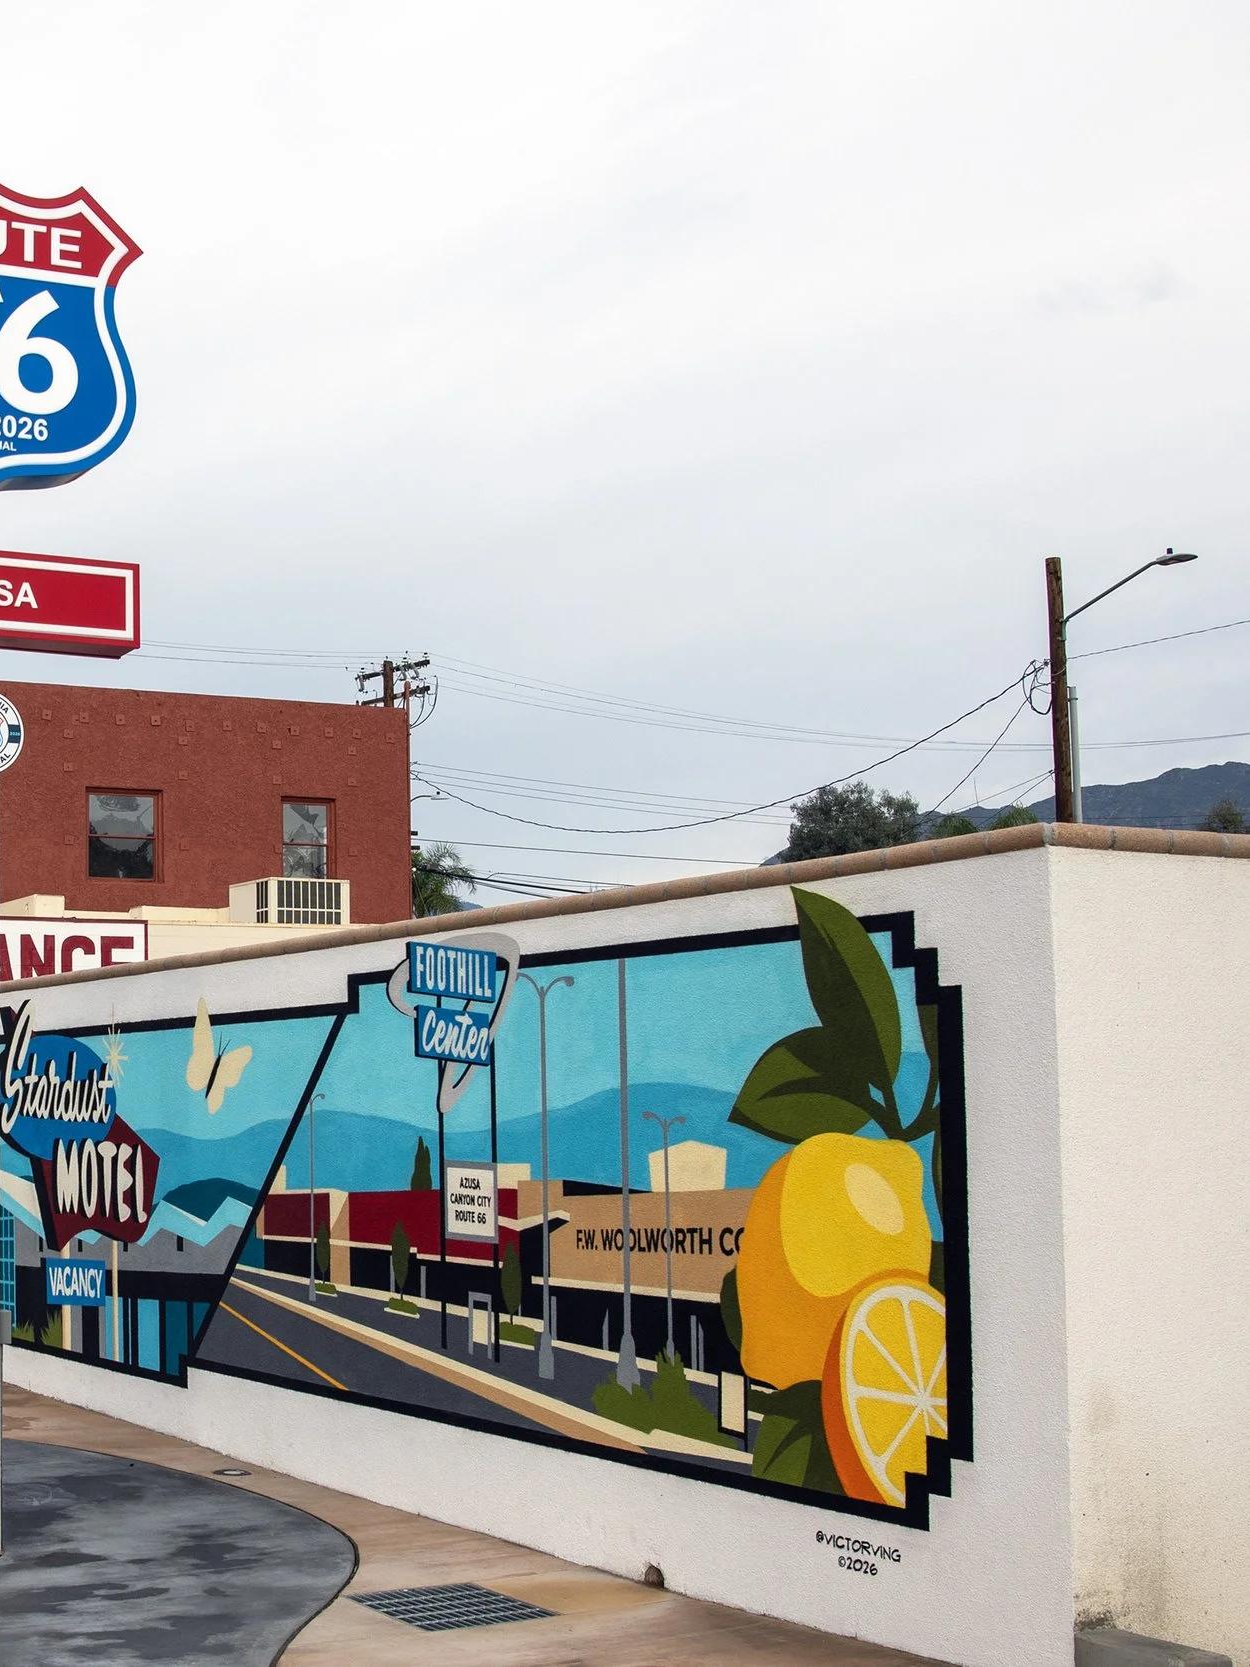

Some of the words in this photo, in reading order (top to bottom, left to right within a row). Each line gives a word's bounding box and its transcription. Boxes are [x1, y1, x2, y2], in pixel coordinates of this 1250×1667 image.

[416, 946, 492, 998] FOOTHILL
[421, 1009, 490, 1061] Center
[1, 999, 114, 1134] Stardust
[56, 1138, 147, 1223] MOTEL
[460, 1176, 481, 1190] AZUSA
[450, 1193, 475, 1206] CANYON
[477, 1195, 492, 1208] CITY
[455, 1209, 475, 1223] ROUTE
[477, 1212, 487, 1225] 66
[576, 1229, 598, 1250] F.W.
[600, 1227, 713, 1255] WOOLWORTH
[49, 1267, 102, 1299] VACANCY
[816, 1530, 901, 1563] @VICTORVING
